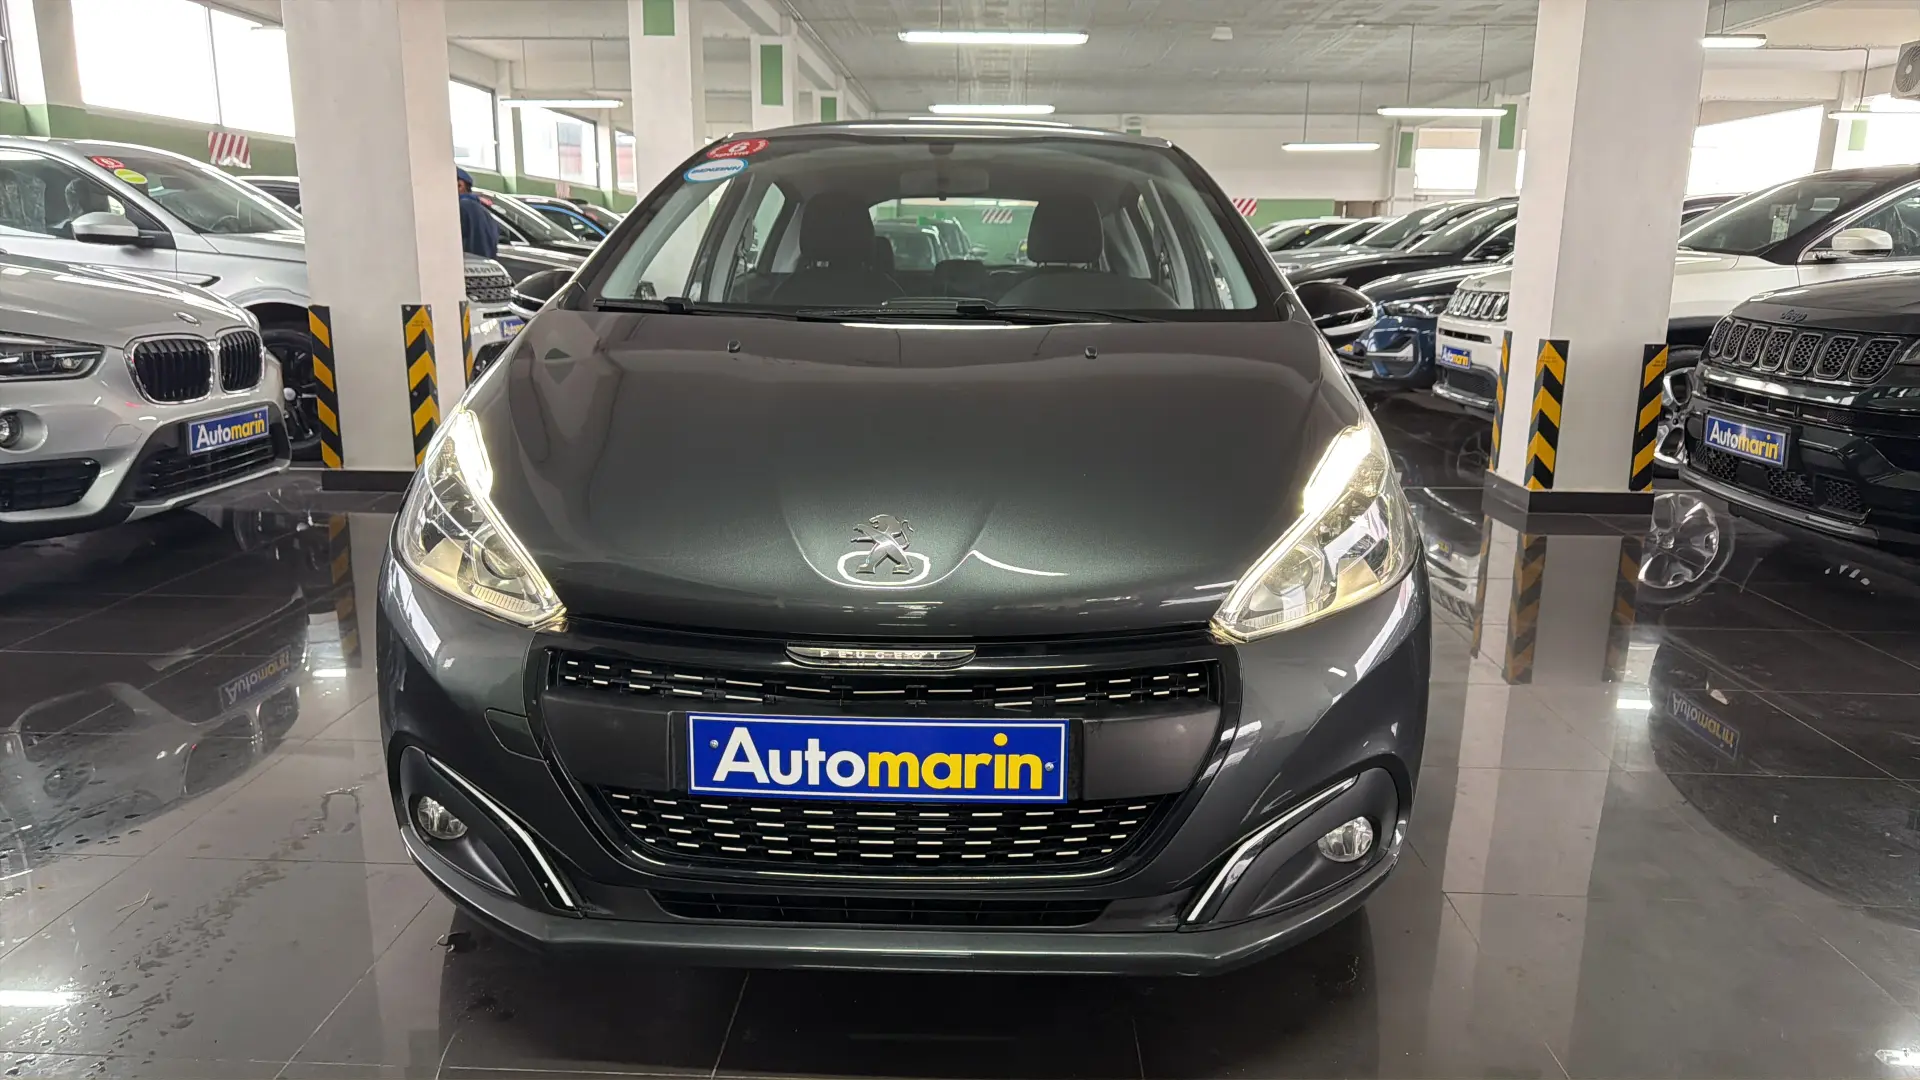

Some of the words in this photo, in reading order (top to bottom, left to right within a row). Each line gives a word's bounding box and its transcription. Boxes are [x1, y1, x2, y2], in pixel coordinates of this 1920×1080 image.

[196, 412, 265, 449] Automarin
[1709, 420, 1778, 460] Automarin
[820, 650, 940, 660] PEUGEOT
[712, 726, 1043, 790] Automarin
